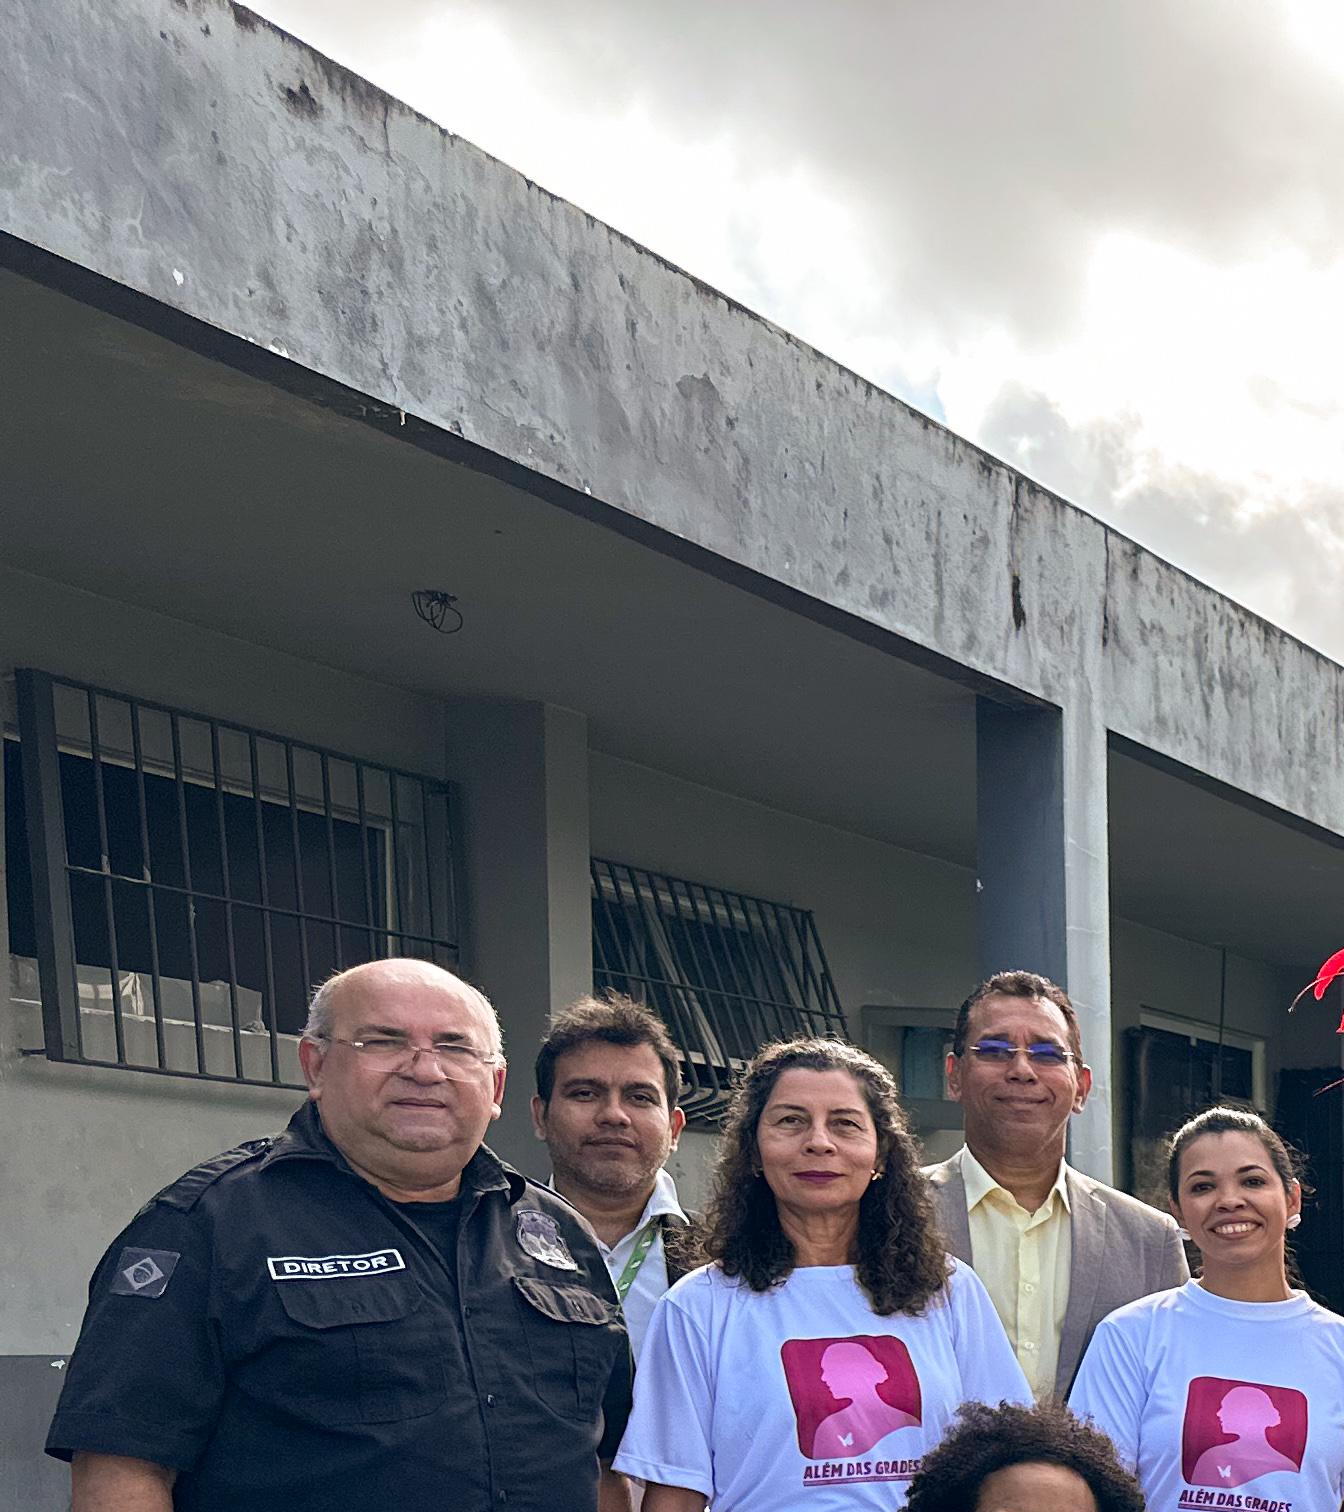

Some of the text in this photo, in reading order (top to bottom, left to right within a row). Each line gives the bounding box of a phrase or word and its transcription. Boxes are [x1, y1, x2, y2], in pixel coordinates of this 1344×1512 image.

[283, 1256, 389, 1274] DIRETOR
[803, 1459, 921, 1479] ALÉM DAS GRADES
[1179, 1488, 1215, 1505] ALÉM
[1216, 1493, 1242, 1507] DAS
